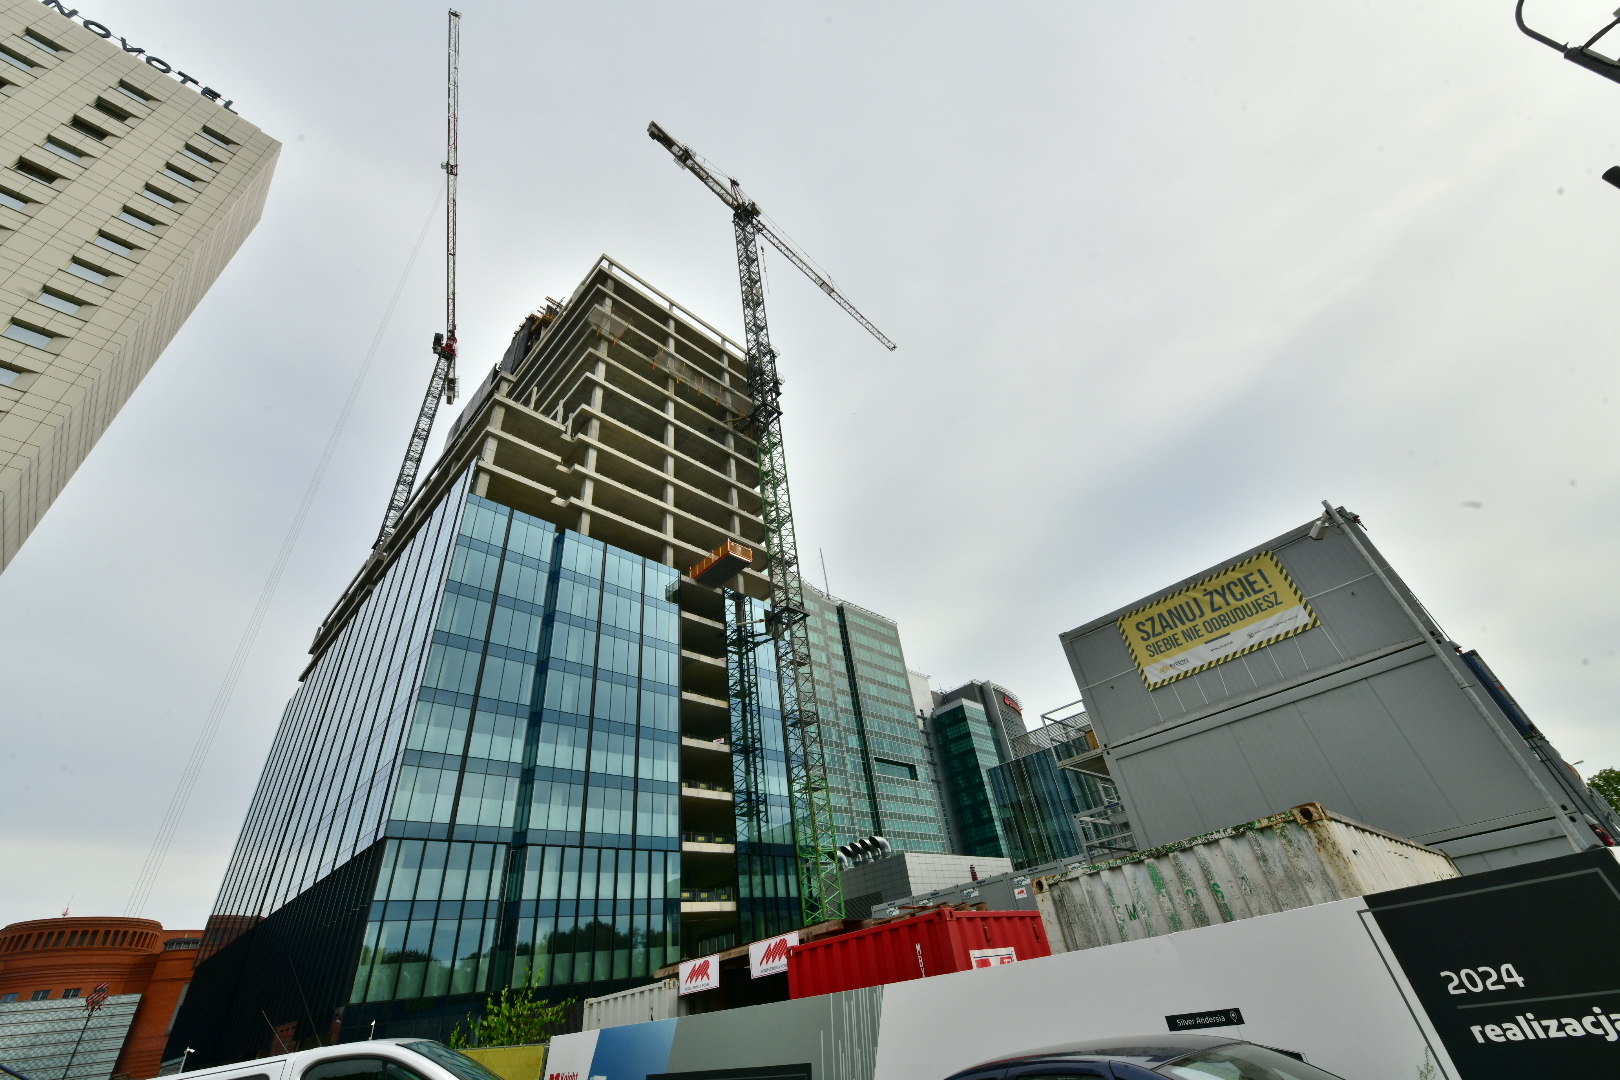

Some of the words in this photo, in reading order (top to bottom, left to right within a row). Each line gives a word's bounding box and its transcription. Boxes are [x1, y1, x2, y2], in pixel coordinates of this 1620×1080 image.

[42, 0, 238, 115] NOVOTEL
[1135, 597, 1205, 642] SZANUJ
[1145, 634, 1183, 658] SIEBIE
[1181, 624, 1204, 648] NIE
[1203, 590, 1283, 634] ODBUDUJESZ
[1439, 963, 1525, 995] 2024
[1176, 1018, 1195, 1027] Silver
[1196, 1013, 1226, 1025] Andersia
